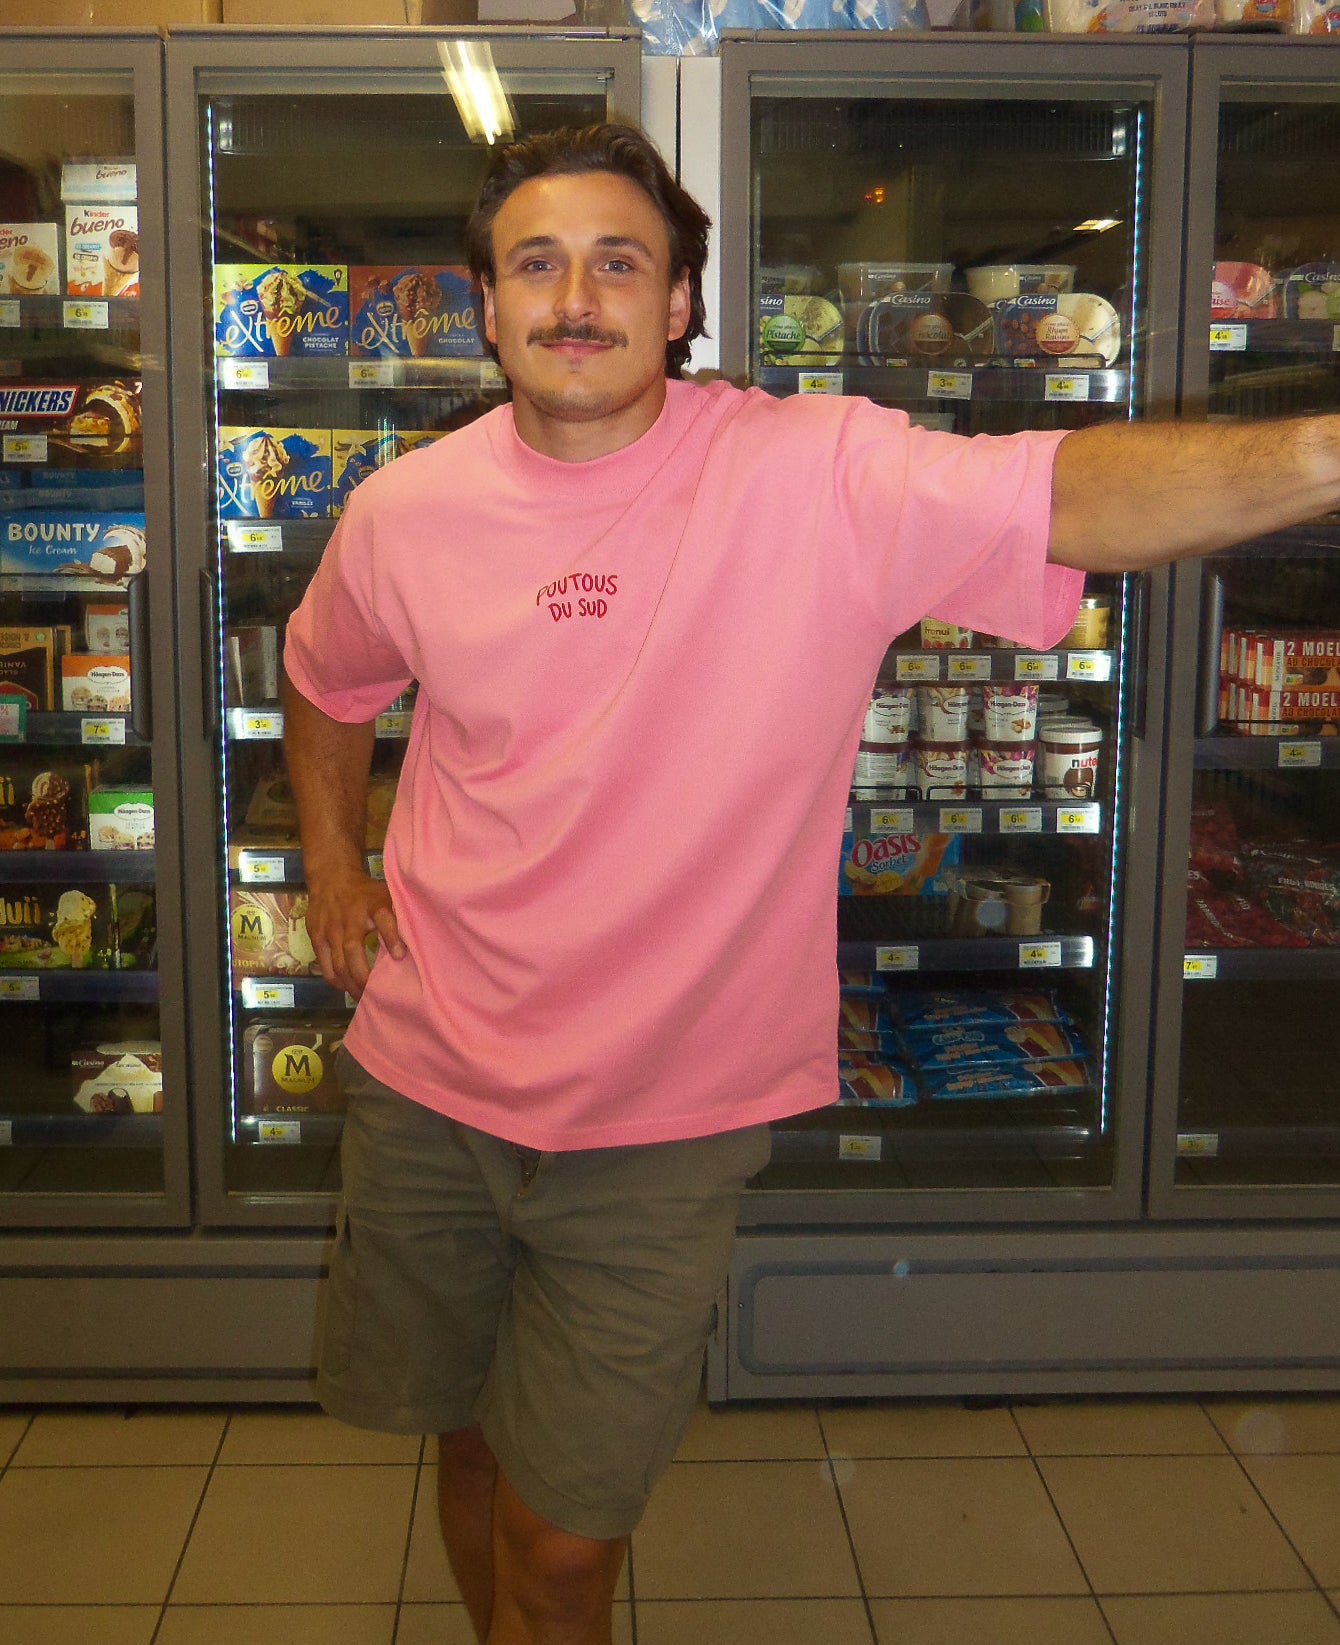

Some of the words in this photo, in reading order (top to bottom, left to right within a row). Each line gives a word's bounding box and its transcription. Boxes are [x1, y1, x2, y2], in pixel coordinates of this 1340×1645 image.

[70, 217, 125, 236] bueno
[891, 294, 931, 305] Casino
[1016, 295, 1057, 306] Casino
[8, 522, 100, 543] BOUNTY
[29, 544, 43, 555] Ice
[45, 544, 78, 556] Cream
[536, 572, 618, 606] POUTOUS
[548, 602, 572, 622] DU
[578, 598, 608, 618] SUD
[1287, 641, 1295, 656] 2
[91, 671, 125, 679] Häagen-Dazs
[1283, 692, 1291, 707] 2
[851, 833, 922, 869] Oasis
[871, 854, 906, 873] Sorbet
[239, 914, 264, 935] M
[284, 1053, 312, 1076] M
